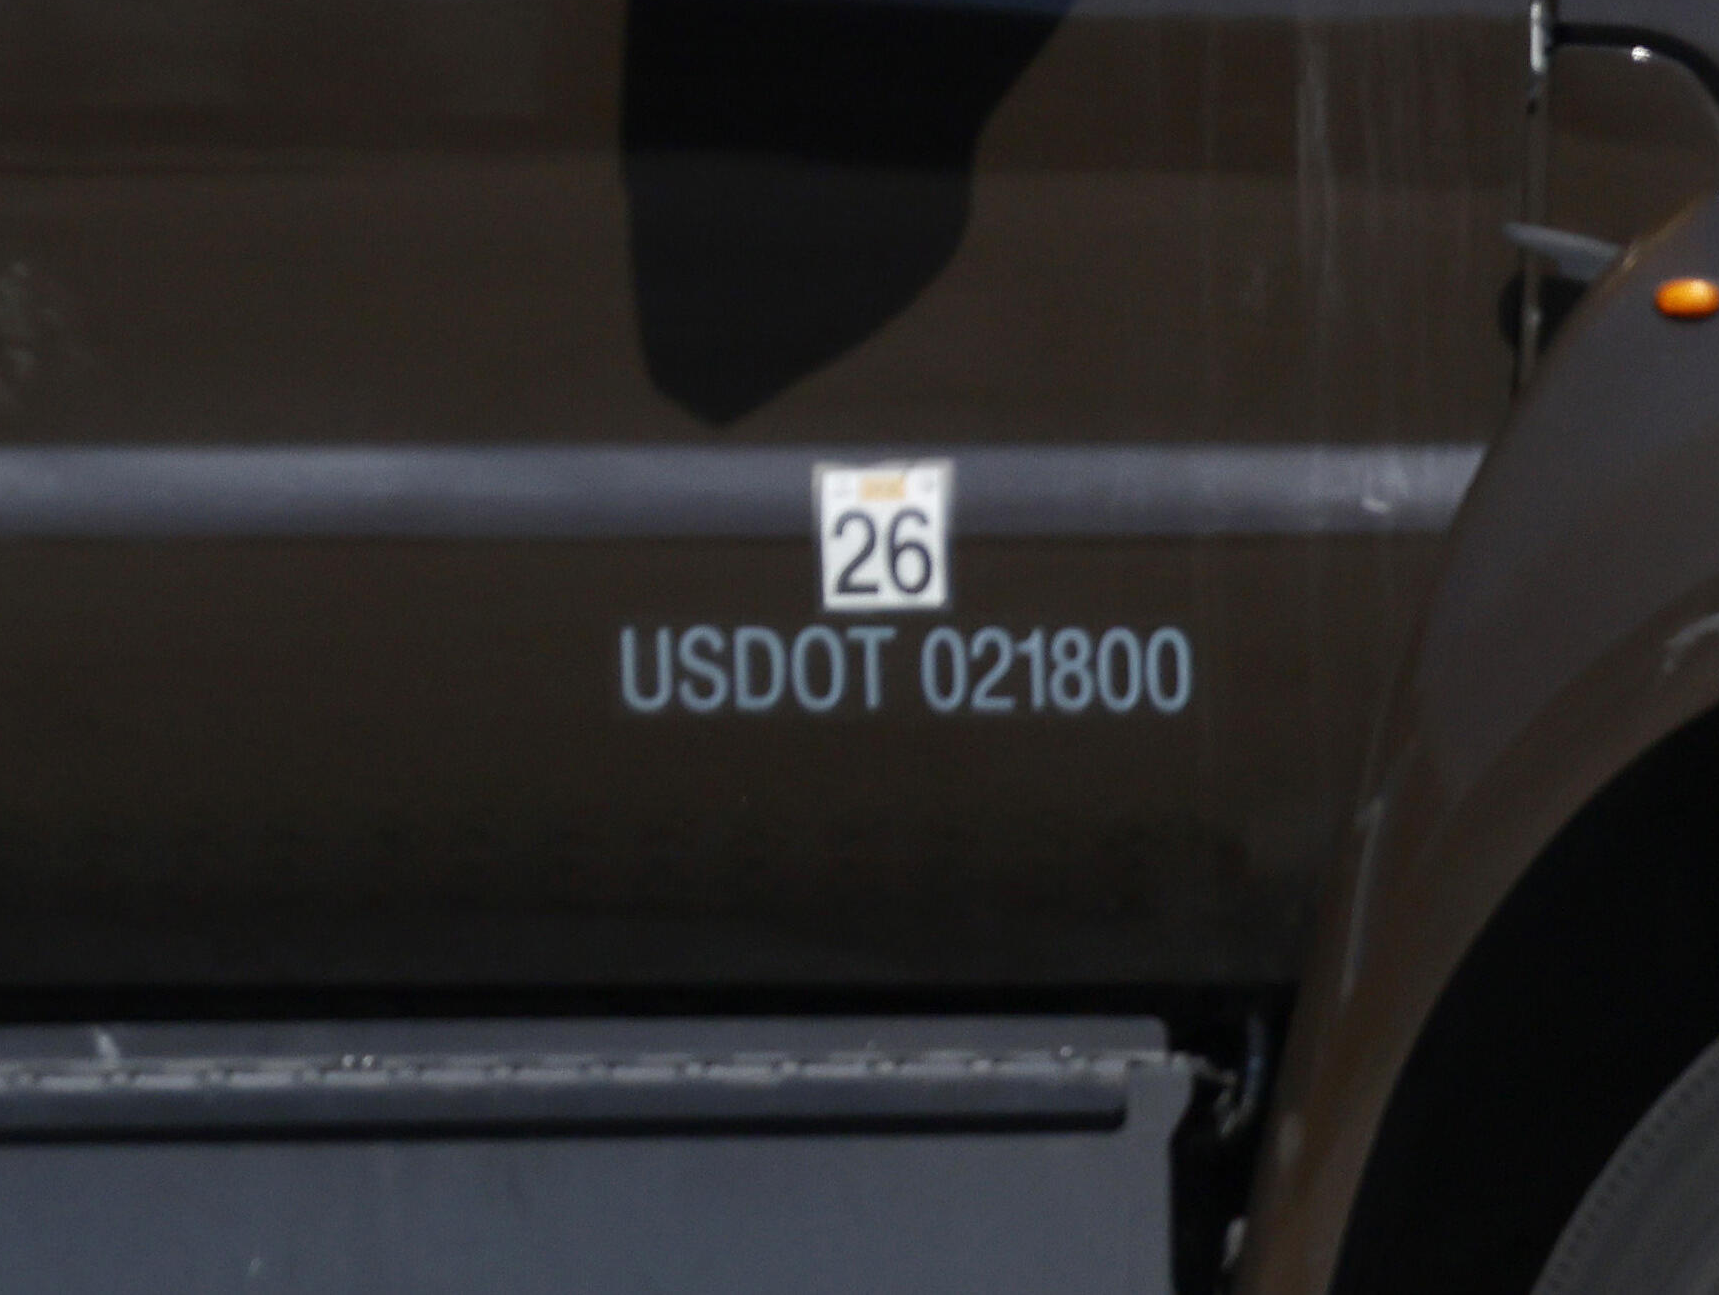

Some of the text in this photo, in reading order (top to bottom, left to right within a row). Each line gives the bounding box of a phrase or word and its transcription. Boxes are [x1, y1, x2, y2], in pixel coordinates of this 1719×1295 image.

[833, 507, 933, 595] 26
[619, 624, 1194, 713] USDOT 021800
